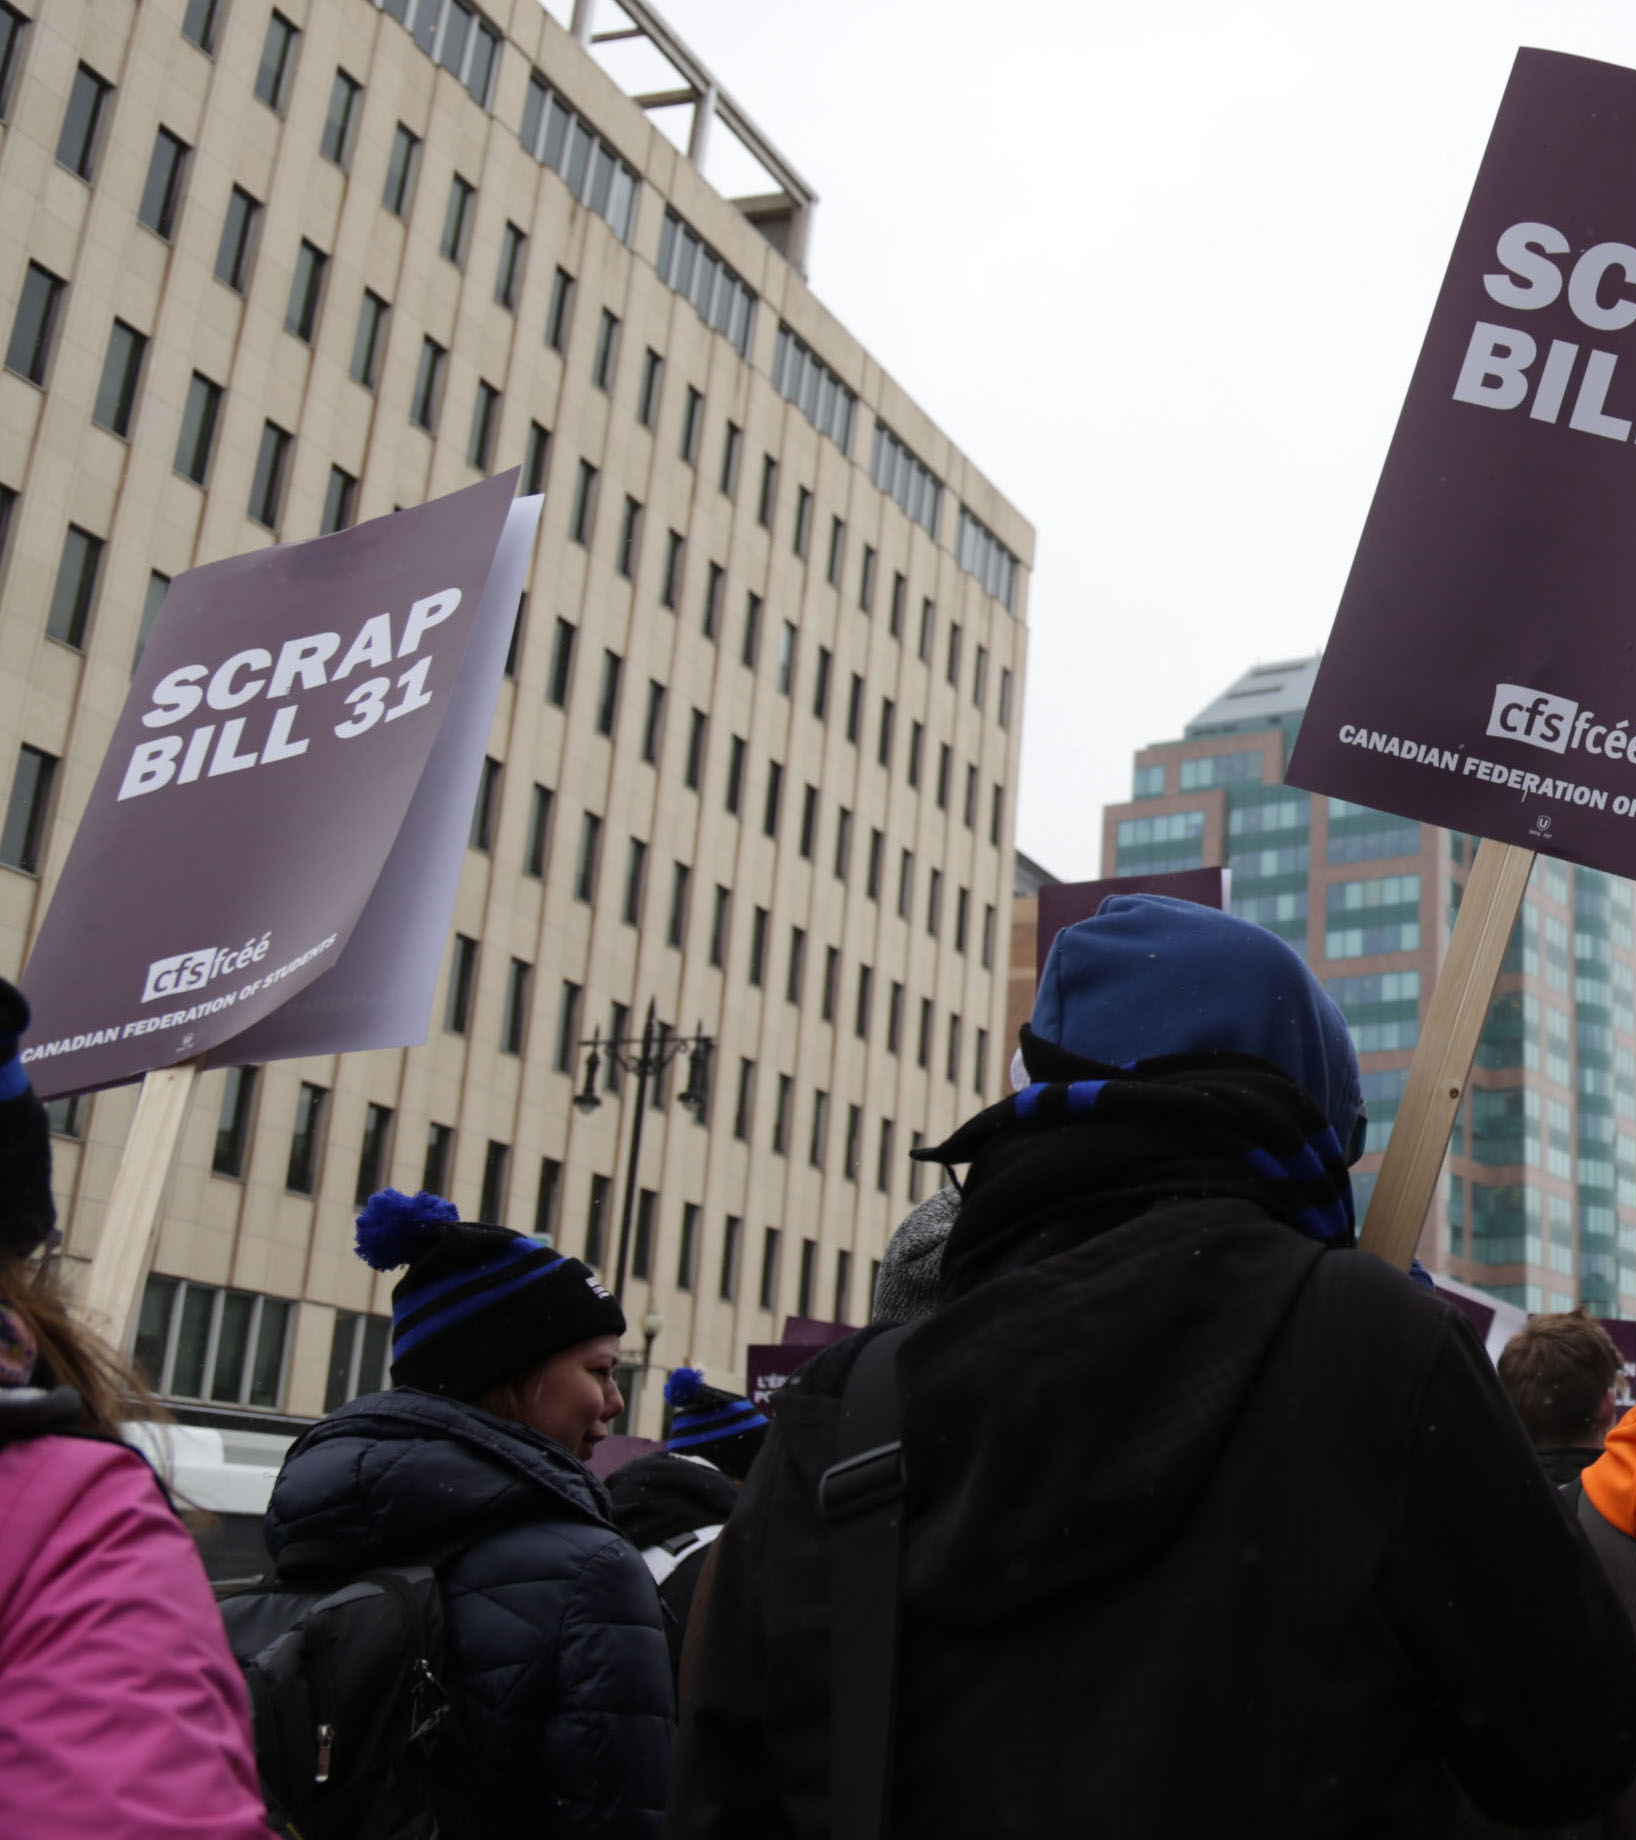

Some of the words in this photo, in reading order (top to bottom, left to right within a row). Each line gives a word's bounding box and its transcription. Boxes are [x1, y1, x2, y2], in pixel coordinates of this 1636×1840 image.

[142, 587, 462, 728] SCRAP
[117, 705, 310, 802] BILL
[334, 655, 433, 739] 31
[1338, 724, 1459, 772] CANADIAN
[1463, 758, 1608, 810] FEDERATION
[20, 1026, 121, 1064] CANADIAN
[122, 991, 235, 1039] FEDERATION
[238, 980, 262, 1001] OF
[262, 933, 337, 988] STUDENTS
